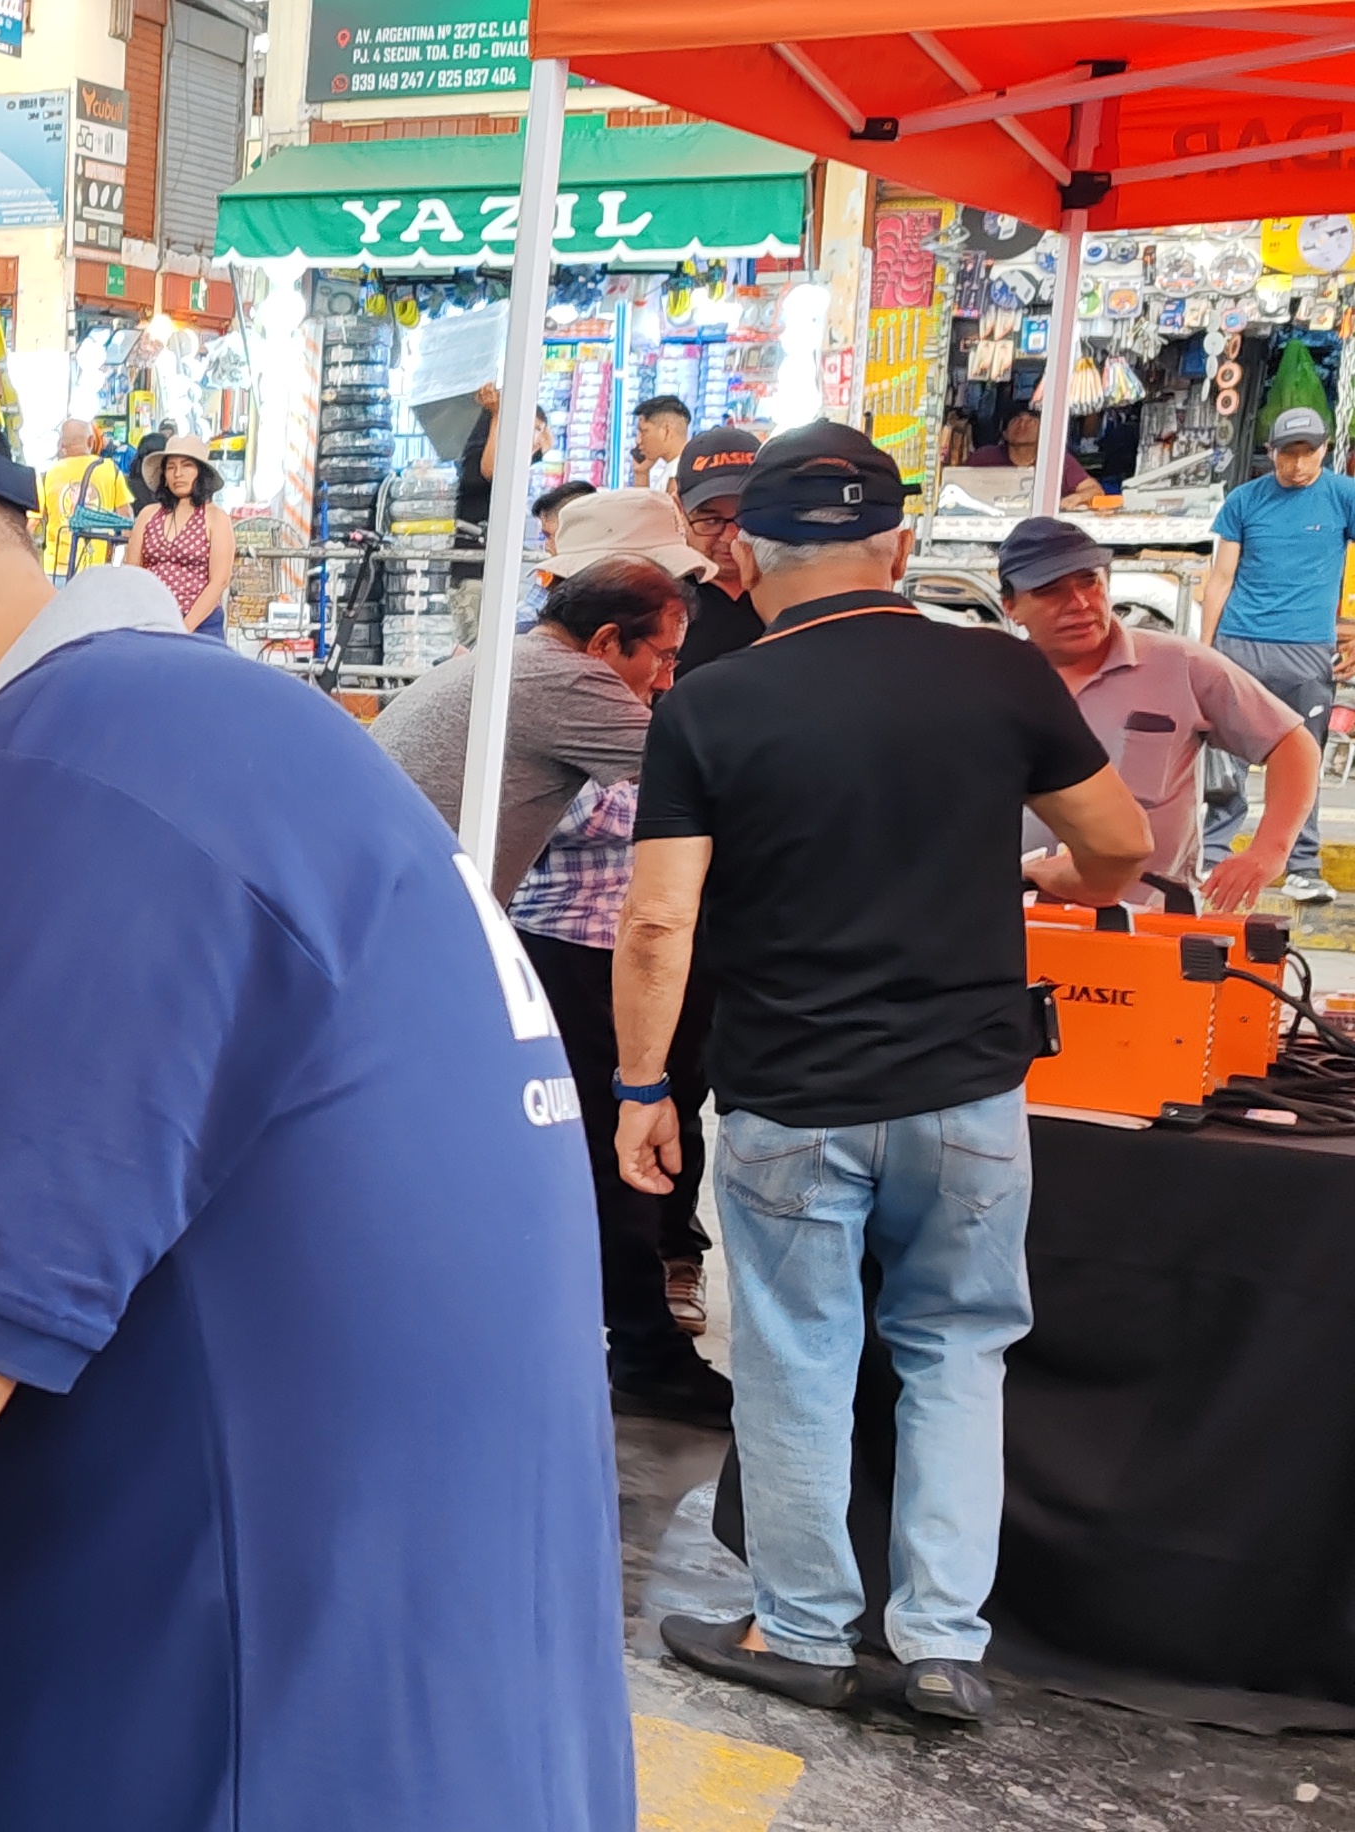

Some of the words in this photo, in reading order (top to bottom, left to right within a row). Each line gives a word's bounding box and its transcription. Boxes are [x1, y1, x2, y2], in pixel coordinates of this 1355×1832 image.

[355, 28, 373, 44] AV.
[375, 25, 435, 43] ARGENTINA
[454, 23, 478, 40] 327
[478, 21, 500, 38] C.C.
[502, 20, 517, 37] LA
[373, 48, 381, 63] 4
[383, 46, 423, 63] SECUN.
[491, 40, 529, 58] OVALO
[351, 73, 375, 92] 939
[378, 72, 398, 90] 149
[400, 71, 425, 90] 247
[438, 69, 462, 88] 925
[465, 68, 489, 86] 937
[491, 67, 516, 85] 404
[342, 190, 653, 243] YAZIL
[1059, 984, 1137, 1007] JASIC
